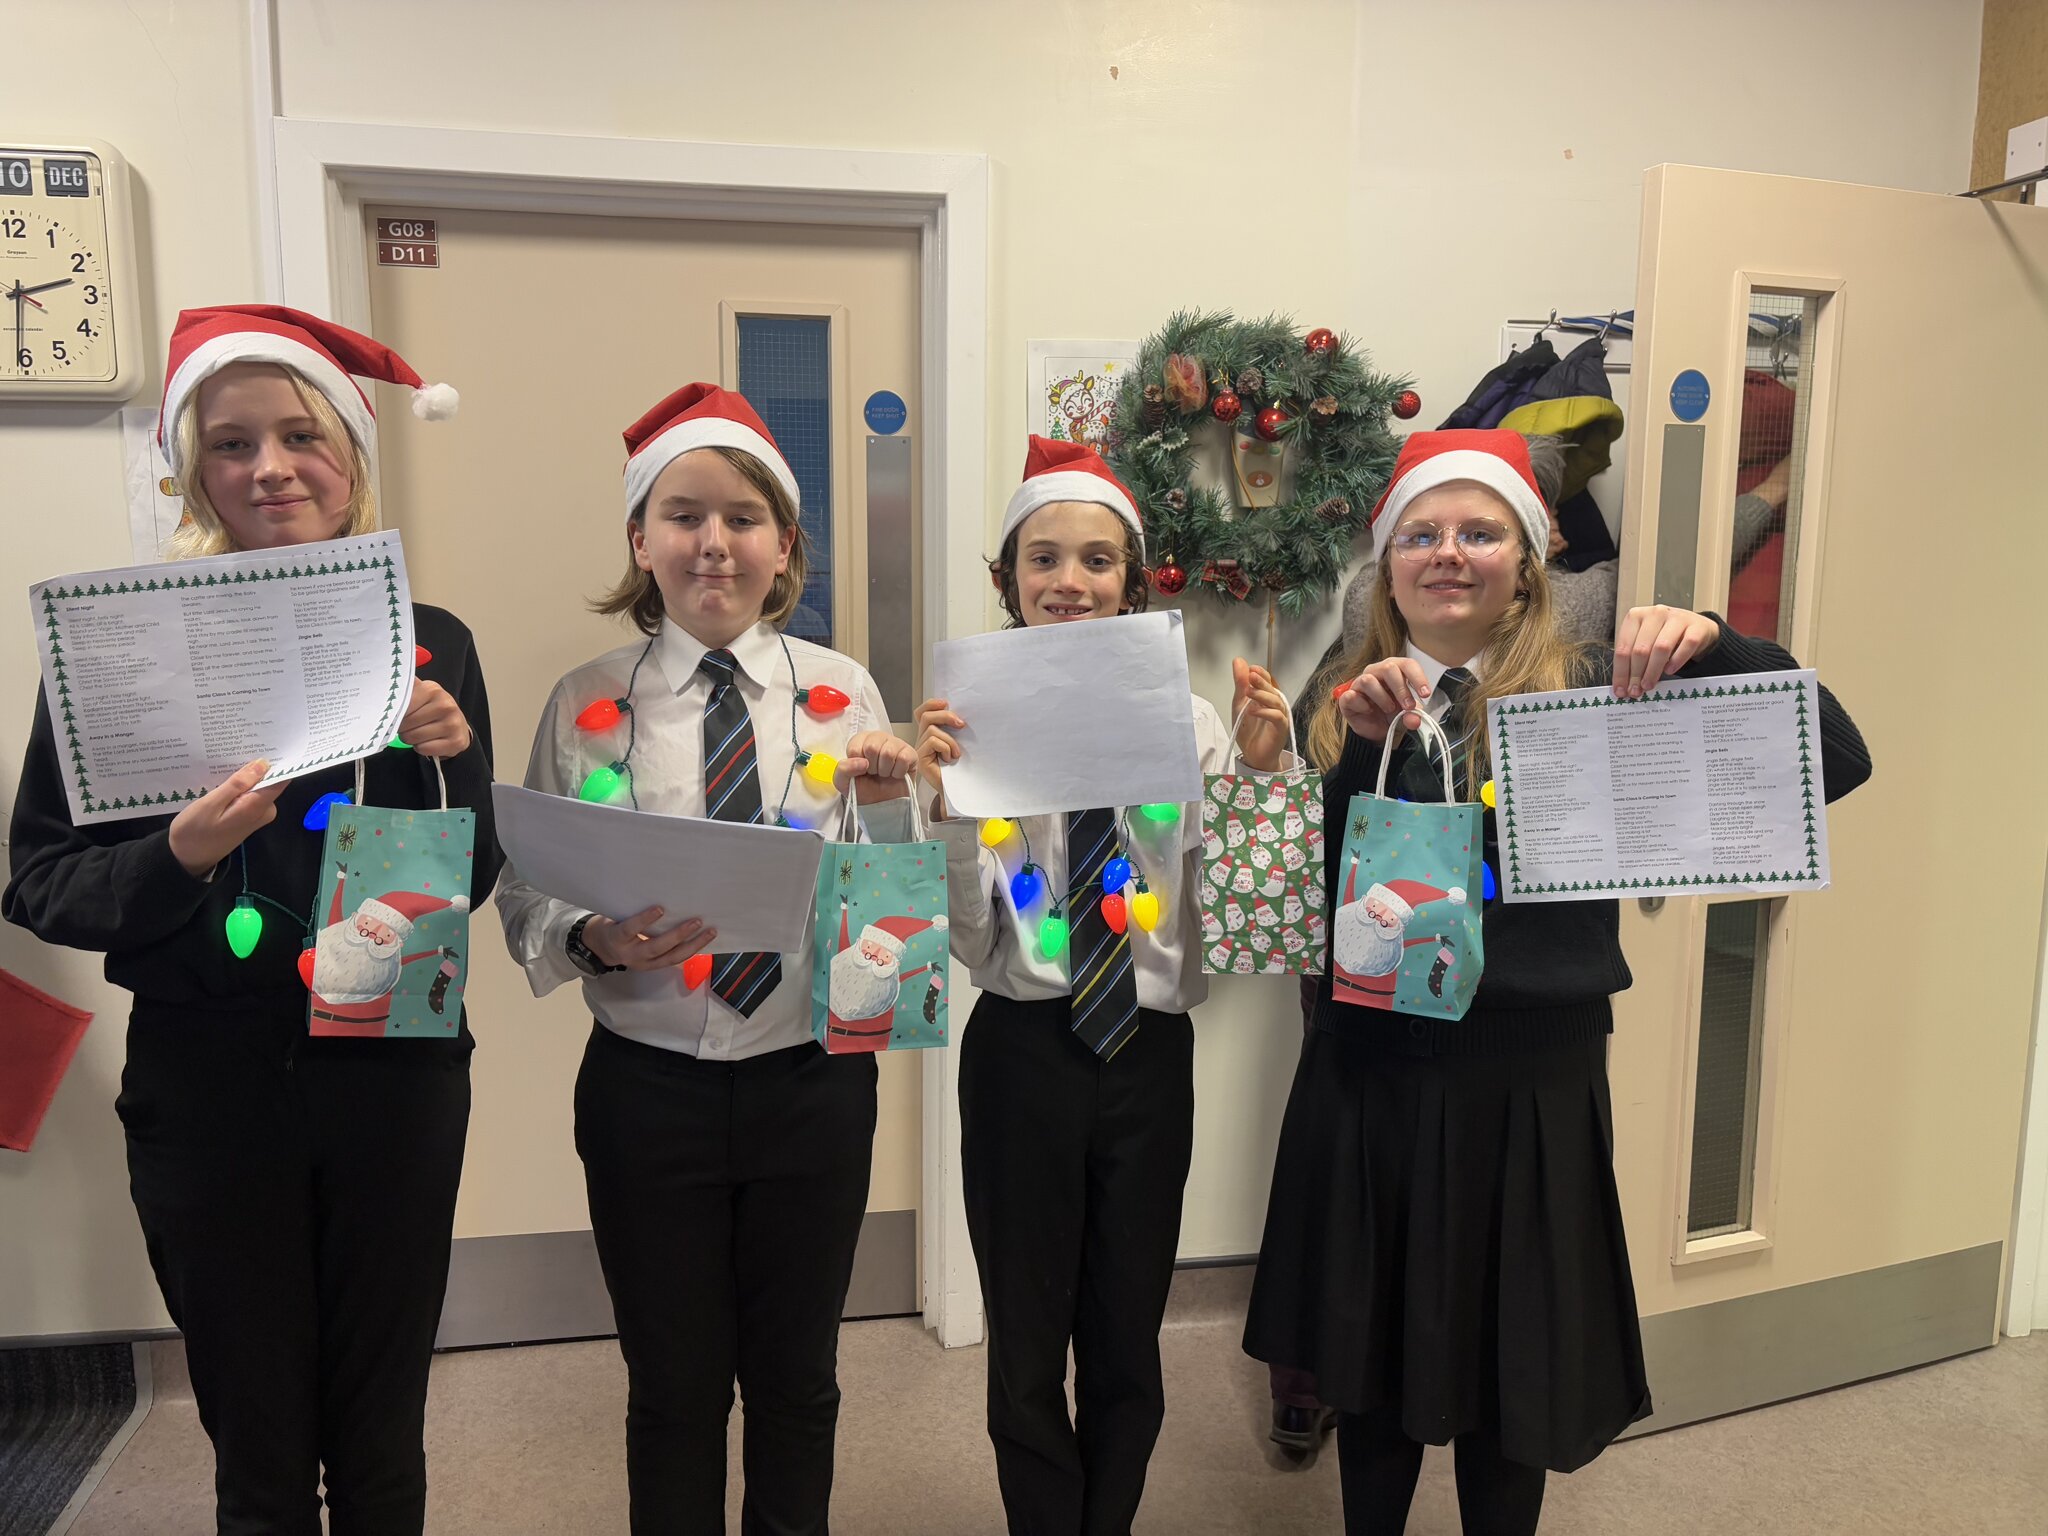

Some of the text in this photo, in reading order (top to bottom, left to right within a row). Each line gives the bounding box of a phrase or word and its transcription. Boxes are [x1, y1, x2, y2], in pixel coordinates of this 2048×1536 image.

[49, 166, 83, 186] DEC
[2, 218, 26, 238] 12
[388, 222, 425, 238] G08
[46, 228, 55, 248] 1
[71, 253, 85, 272] 2
[392, 246, 425, 262] D11
[84, 285, 98, 304] 3
[77, 318, 91, 337] 4
[19, 348, 33, 368] 6
[52, 341, 66, 360] 5
